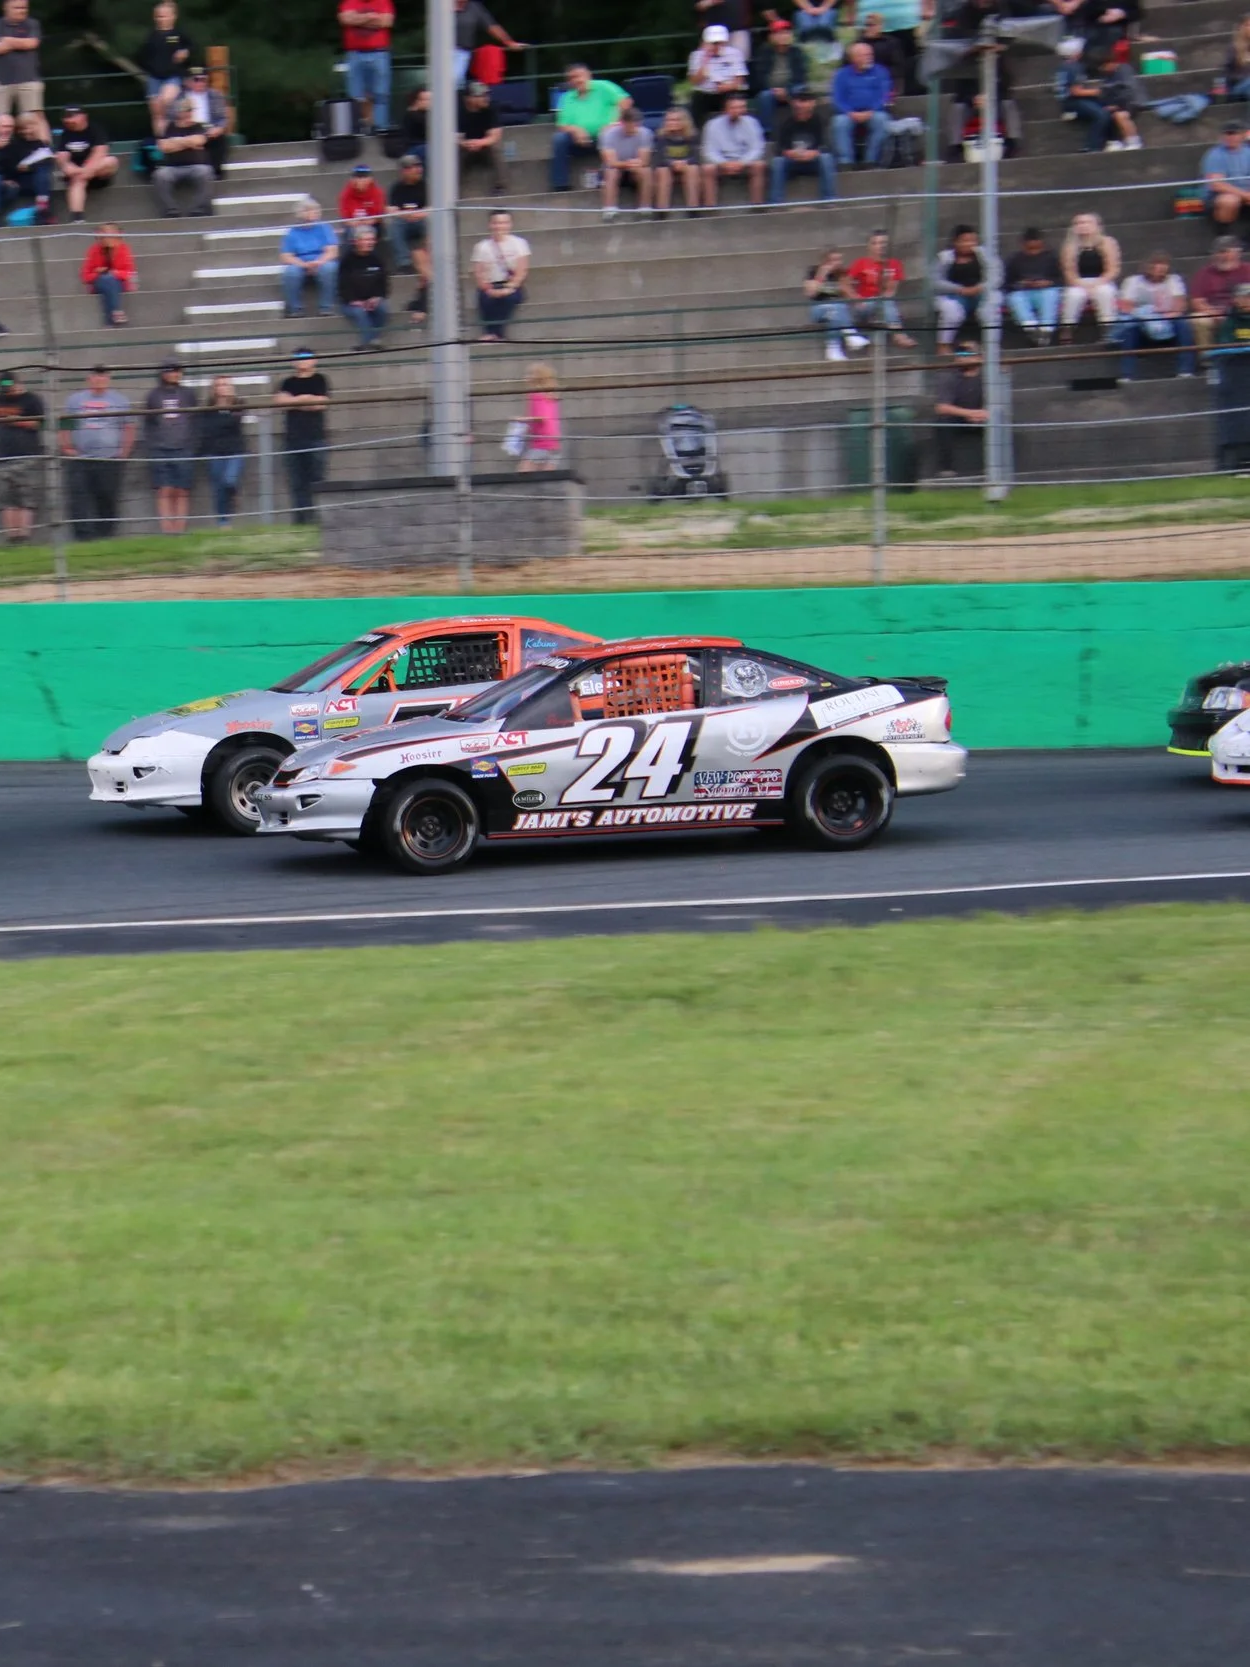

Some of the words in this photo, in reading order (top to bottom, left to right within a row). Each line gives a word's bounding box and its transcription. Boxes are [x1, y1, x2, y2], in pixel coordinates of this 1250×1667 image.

[325, 697, 358, 714] ACT
[494, 731, 529, 746] ACT
[400, 750, 442, 764] Hoosier
[560, 720, 695, 805] 24
[727, 771, 754, 783] POST
[513, 810, 593, 831] JAMI'S
[596, 802, 758, 826] AUTOMOTIVE
